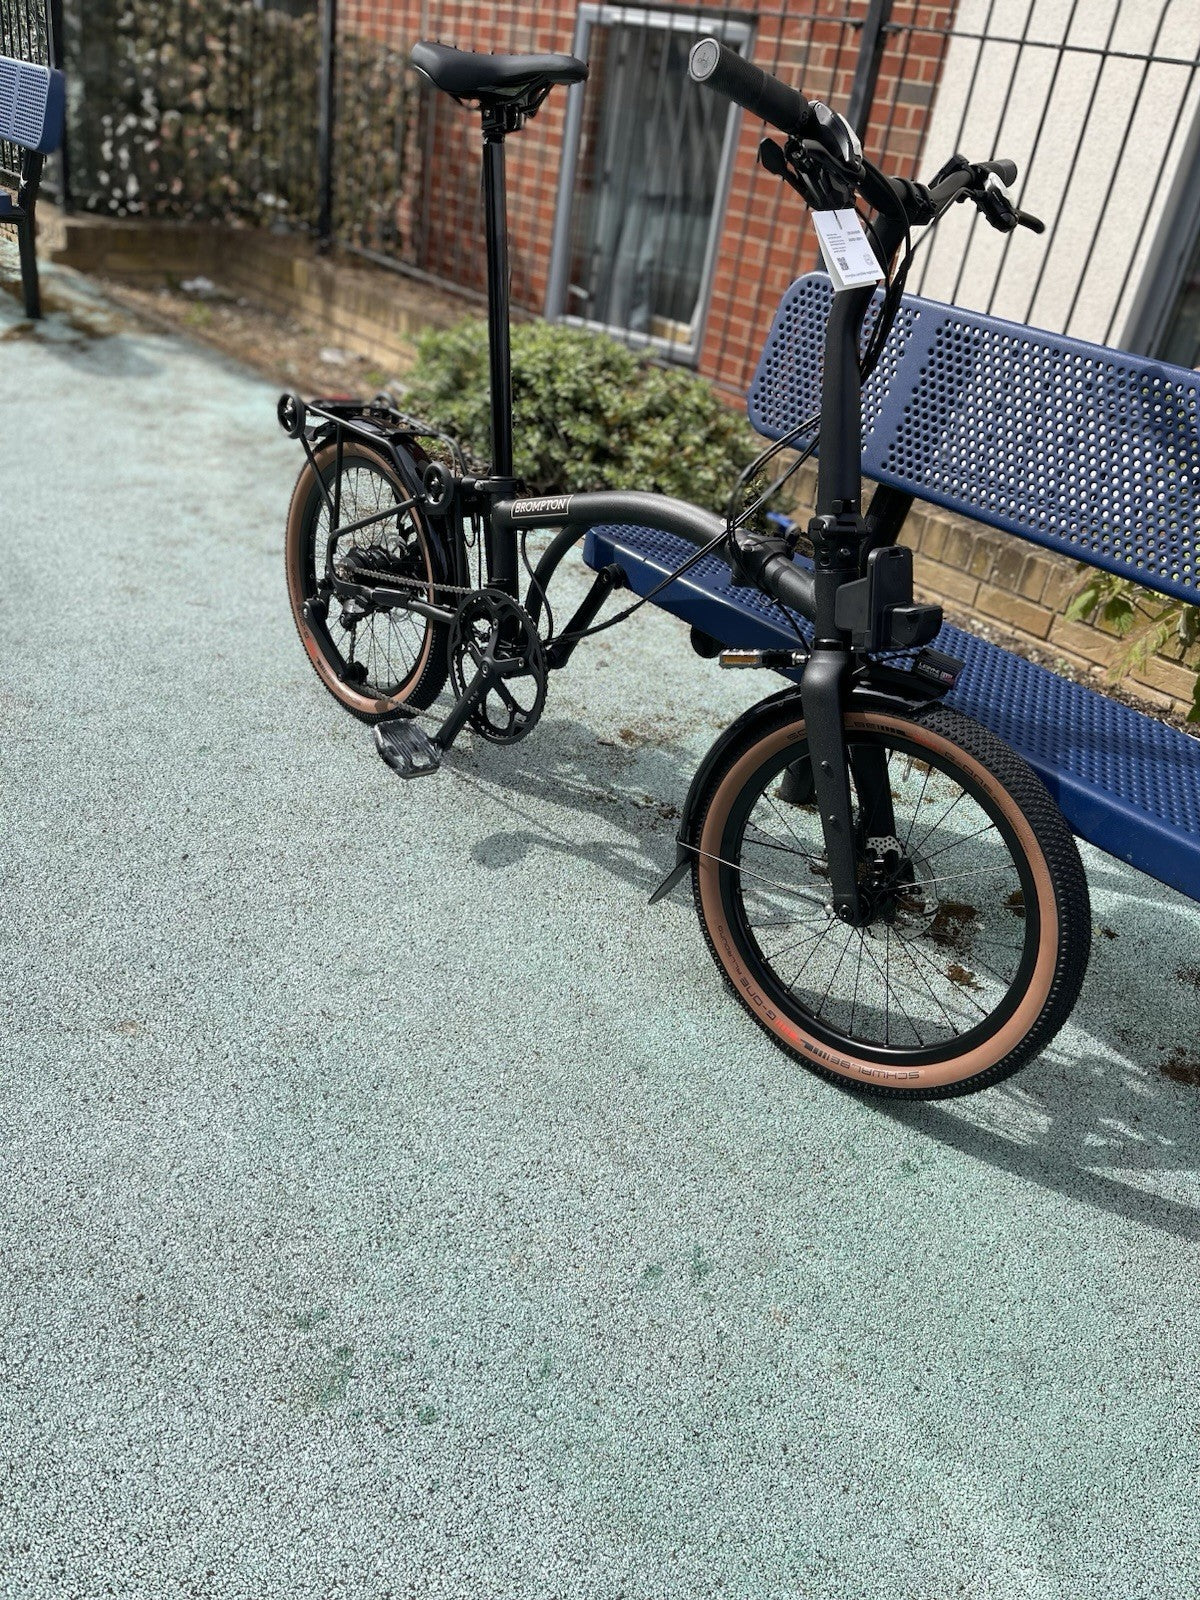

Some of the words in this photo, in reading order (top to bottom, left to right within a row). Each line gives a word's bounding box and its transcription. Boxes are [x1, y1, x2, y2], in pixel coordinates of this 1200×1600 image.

[515, 499, 566, 513] BROMPTON
[740, 978, 777, 1021] G-ONE
[830, 1058, 920, 1080] SCHWALBE
